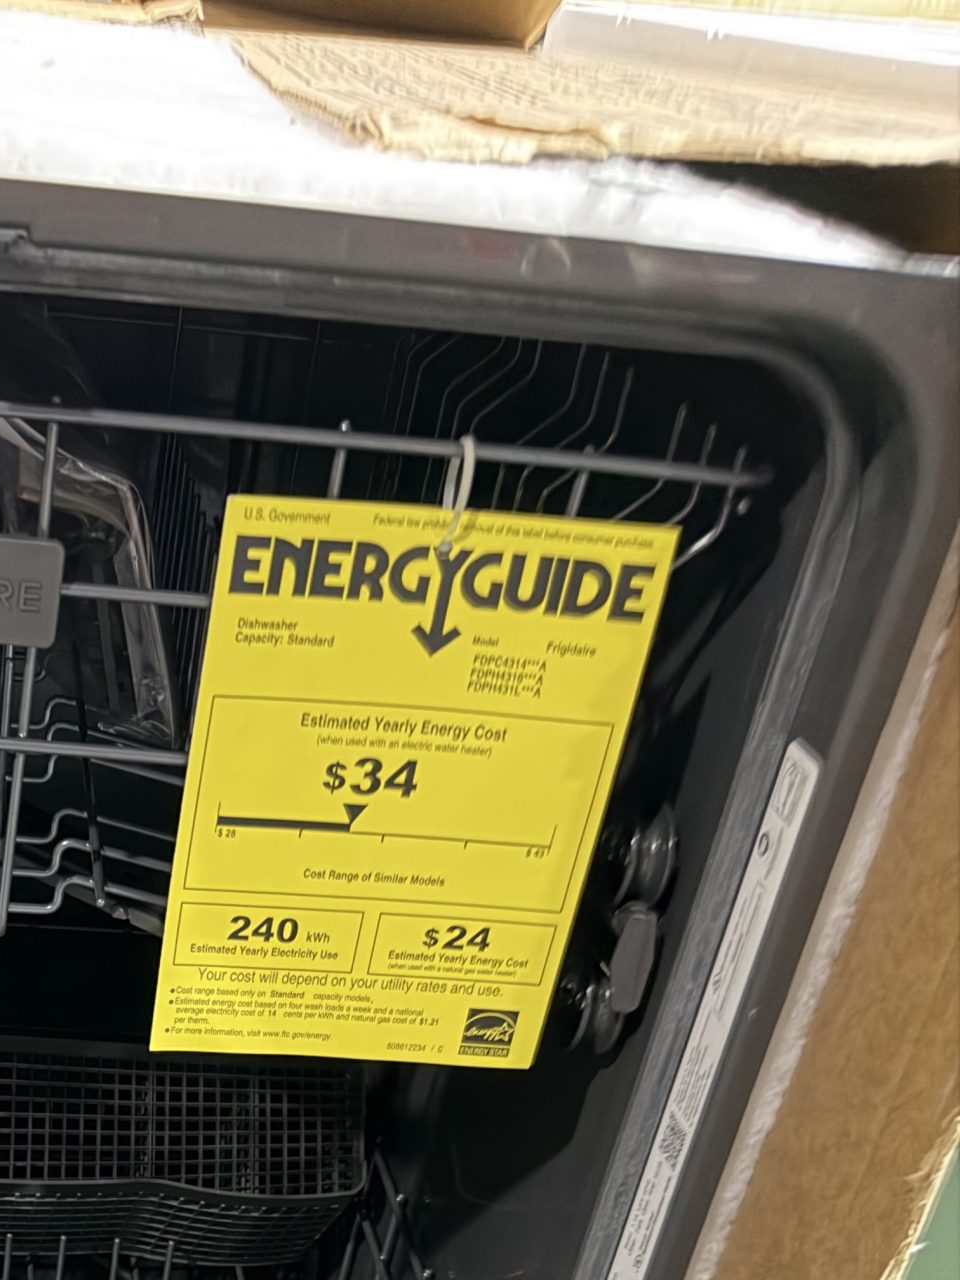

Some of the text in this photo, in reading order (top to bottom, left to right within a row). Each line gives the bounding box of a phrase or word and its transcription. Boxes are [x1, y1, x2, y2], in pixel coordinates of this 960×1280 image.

[244, 507, 331, 525] U.S. Government
[373, 513, 405, 528] Federal
[237, 617, 298, 631] Dishwasher
[235, 630, 335, 648] Capacity: Standard
[472, 635, 499, 647] Model
[546, 640, 597, 658] Frigidaire
[300, 712, 508, 742] Estimated Yearly Energy Cost
[316, 734, 493, 759] (when used with an electric water heater)
[322, 757, 418, 799] $34
[303, 868, 446, 888] Cost Range of Similar Models
[227, 915, 330, 944] 240 kWh
[422, 925, 491, 952] $24
[190, 943, 339, 961] Estimated Yearly Electricity Use
[388, 950, 529, 969] Estimated Yearly Energy Cost
[198, 968, 504, 997] Your cost will depend on your utility rates and use.
[176, 986, 193, 995] Cost
[194, 987, 215, 997] range
[217, 987, 239, 996] based
[240, 988, 255, 998] only
[270, 990, 305, 999] Standard
[313, 992, 344, 1002] capacity
[174, 997, 210, 1006] Estimated
[211, 999, 236, 1008] energy
[238, 1000, 253, 1008] cost
[254, 1000, 276, 1009] based
[289, 1001, 303, 1010] four
[304, 1002, 323, 1011] wash
[325, 1003, 344, 1012] loads
[352, 1005, 372, 1014] week
[373, 1006, 387, 1015] and
[395, 1008, 424, 1017] national
[174, 1016, 210, 1025] per therm.
[175, 1007, 204, 1016] average
[206, 1007, 239, 1018] electricity
[304, 1012, 317, 1020] per
[318, 1011, 334, 1019] kWh
[335, 1013, 350, 1021] and
[351, 1014, 376, 1023] natural
[377, 1016, 390, 1025] gas
[392, 1016, 407, 1024] cost
[409, 1017, 416, 1025] of
[419, 1017, 439, 1026] $1.21
[170, 1026, 183, 1034] For
[204, 1027, 245, 1037] information,
[247, 1029, 261, 1037] visit
[460, 1046, 508, 1057] ENERGY STAR
